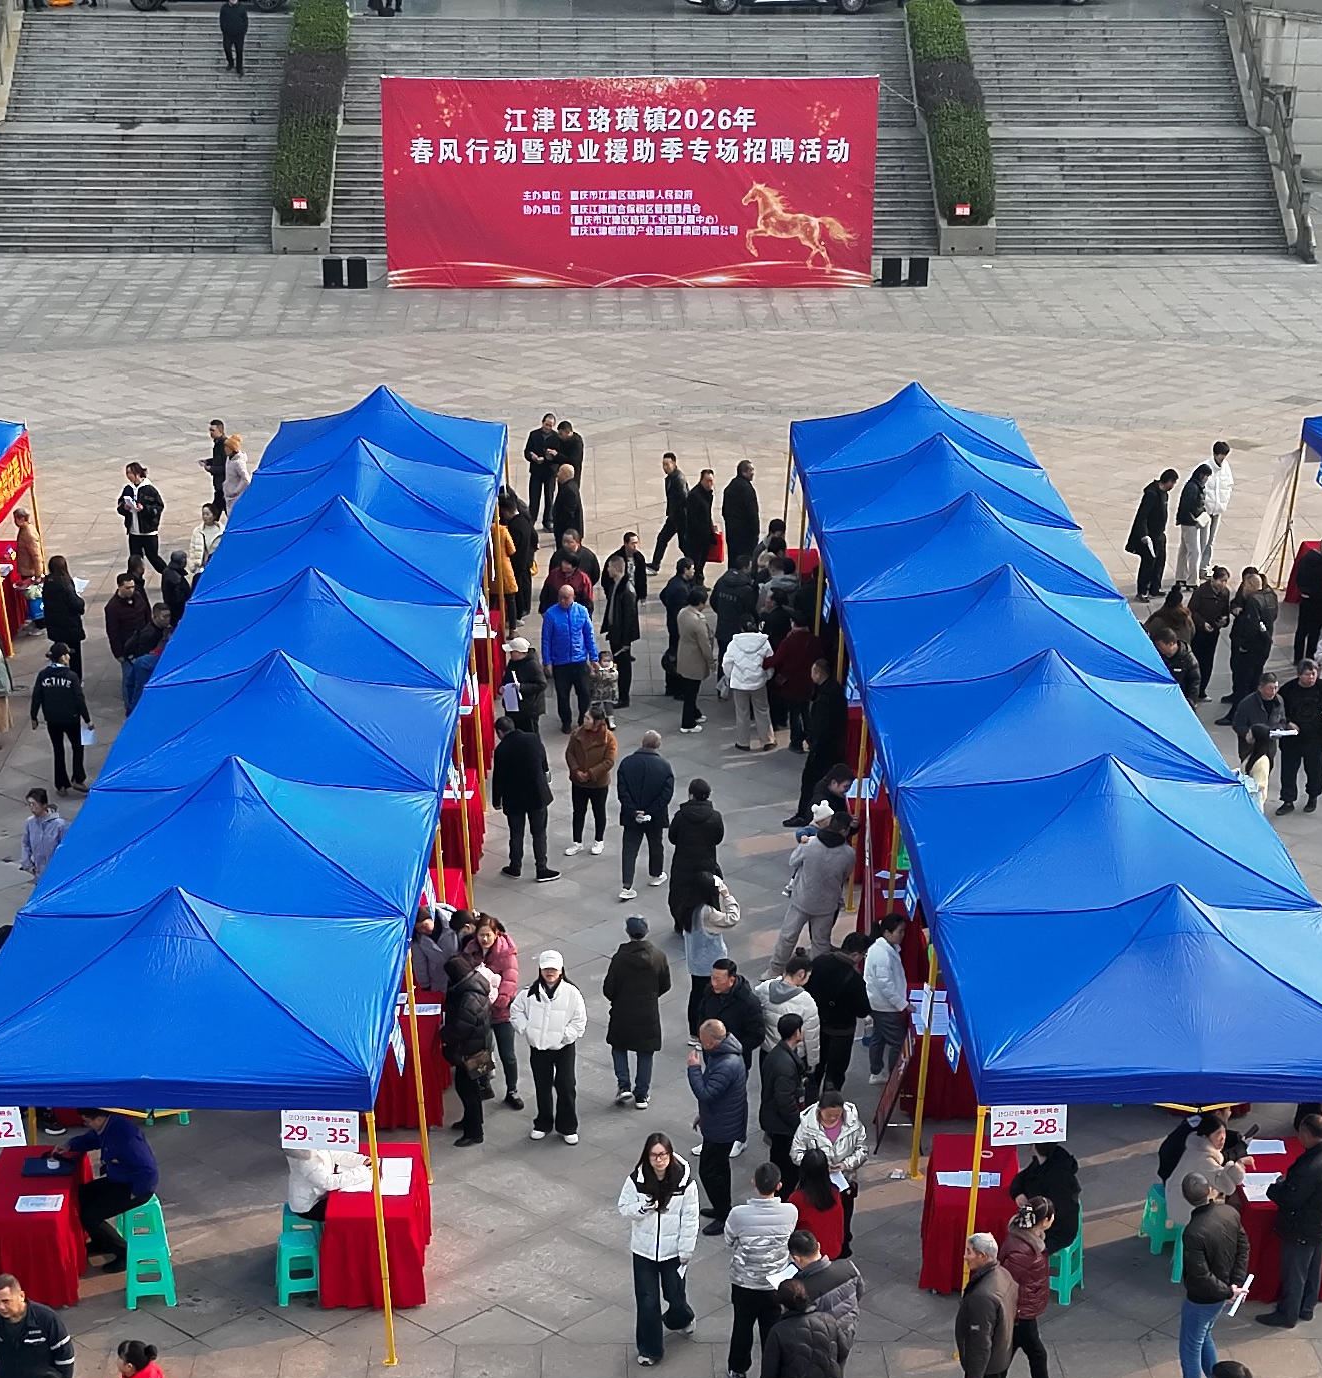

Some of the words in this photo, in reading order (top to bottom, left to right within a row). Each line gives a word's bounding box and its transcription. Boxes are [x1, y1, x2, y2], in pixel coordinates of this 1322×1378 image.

[503, 106, 757, 133] 江津区珞璜镇2026年
[409, 138, 851, 165] 春风行动暨就业援助季专场招聘活动
